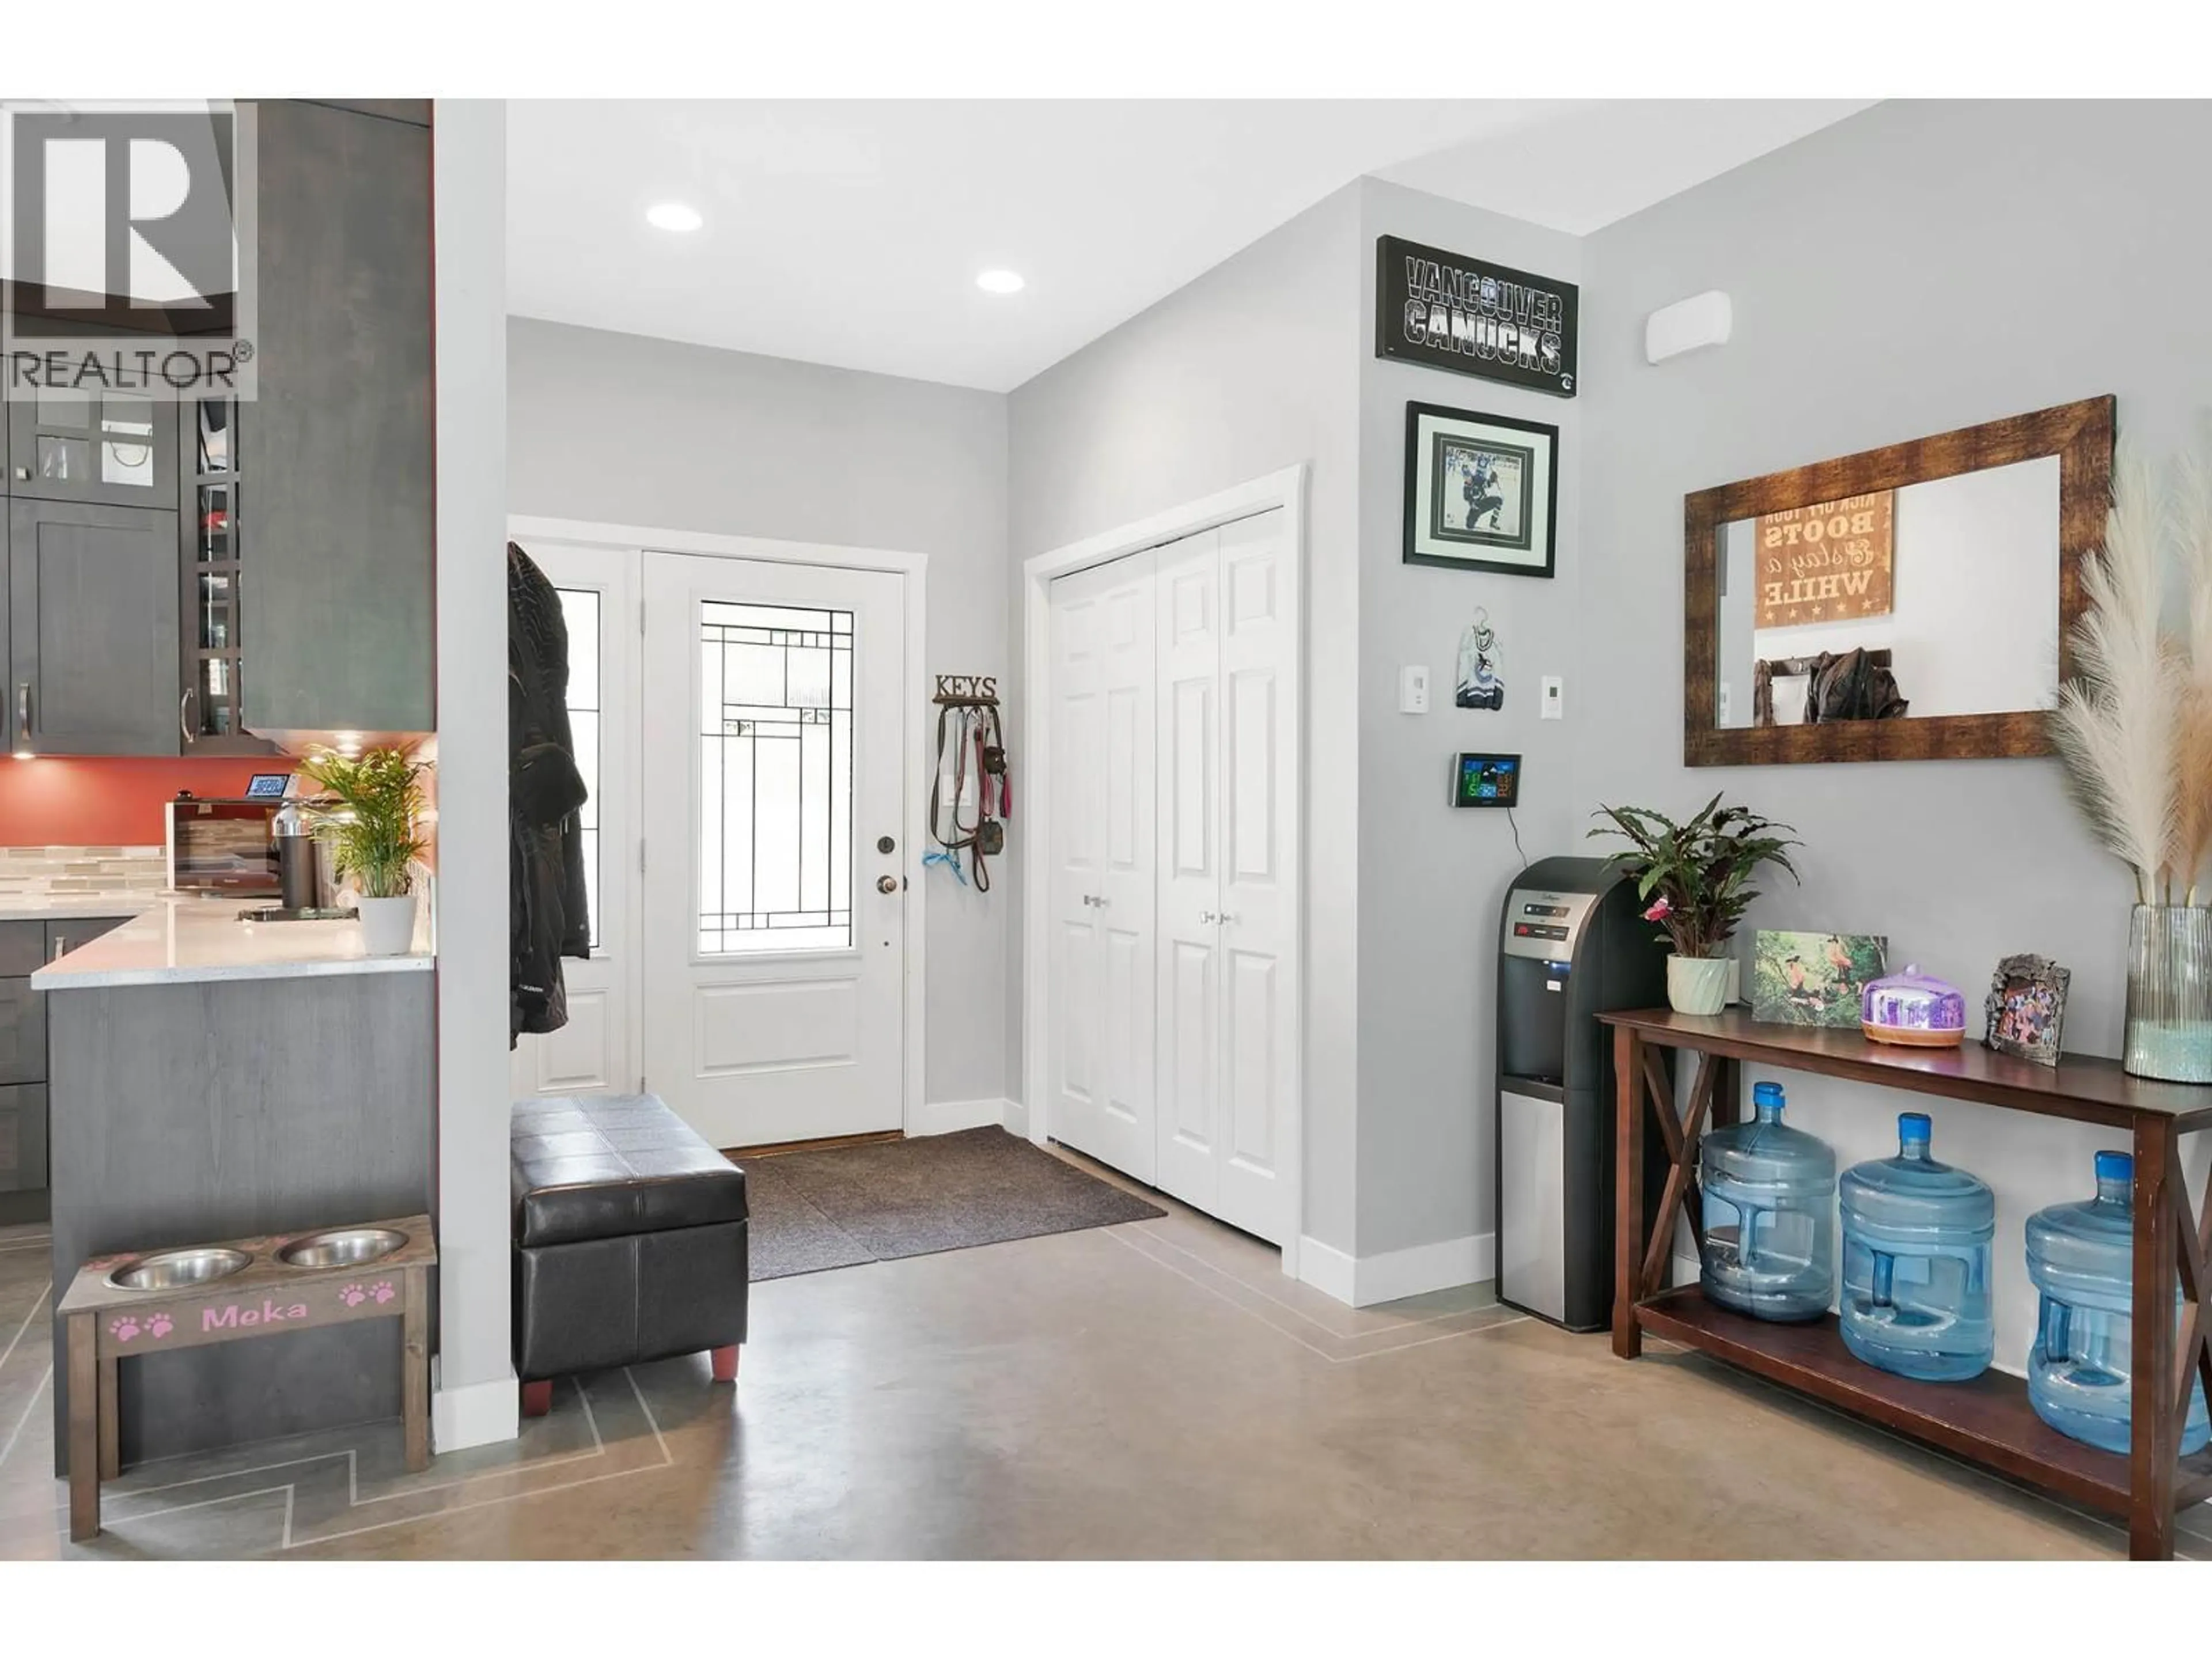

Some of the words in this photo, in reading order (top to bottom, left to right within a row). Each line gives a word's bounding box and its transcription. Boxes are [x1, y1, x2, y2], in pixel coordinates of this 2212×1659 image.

[1406, 256, 1563, 334] VANCOUVER
[1404, 298, 1561, 375] CANUCKS
[935, 675, 996, 698] KEYS
